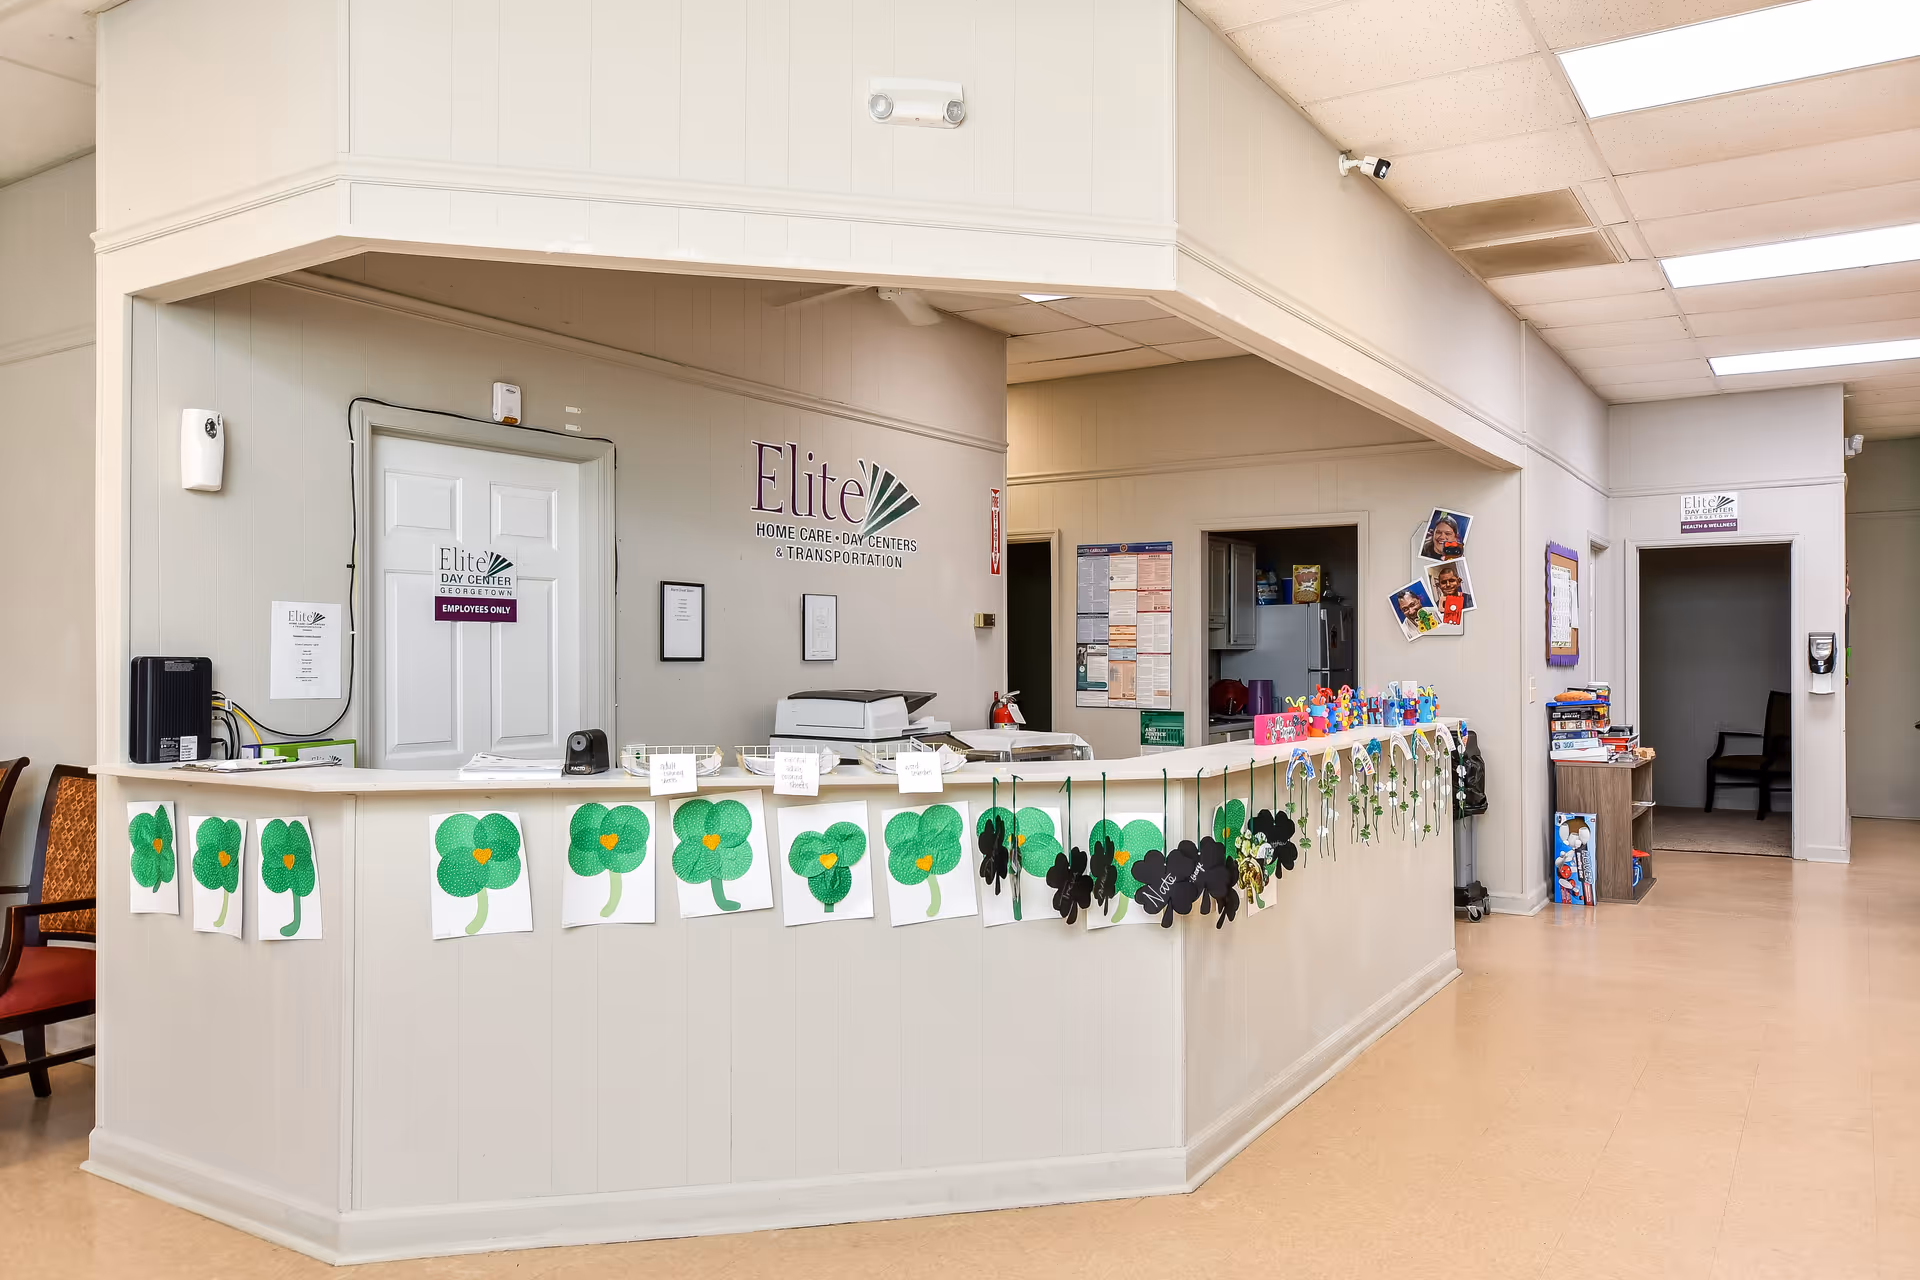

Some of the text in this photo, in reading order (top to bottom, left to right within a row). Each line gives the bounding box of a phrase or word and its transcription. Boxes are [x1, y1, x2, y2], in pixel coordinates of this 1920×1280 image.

[750, 440, 864, 524] Elite
[1684, 495, 1715, 508] Elite
[756, 523, 918, 552] HOME CARE DAY CENTERS
[439, 546, 487, 573] Elite
[774, 546, 903, 569] & TRANSPORTATION
[441, 573, 512, 586] DAY CENTER
[440, 587, 512, 596] GEORGETOWN
[288, 610, 313, 622] Elite
[442, 604, 511, 614] EMPLOYEES ONLY
[1142, 872, 1177, 908] Nate
